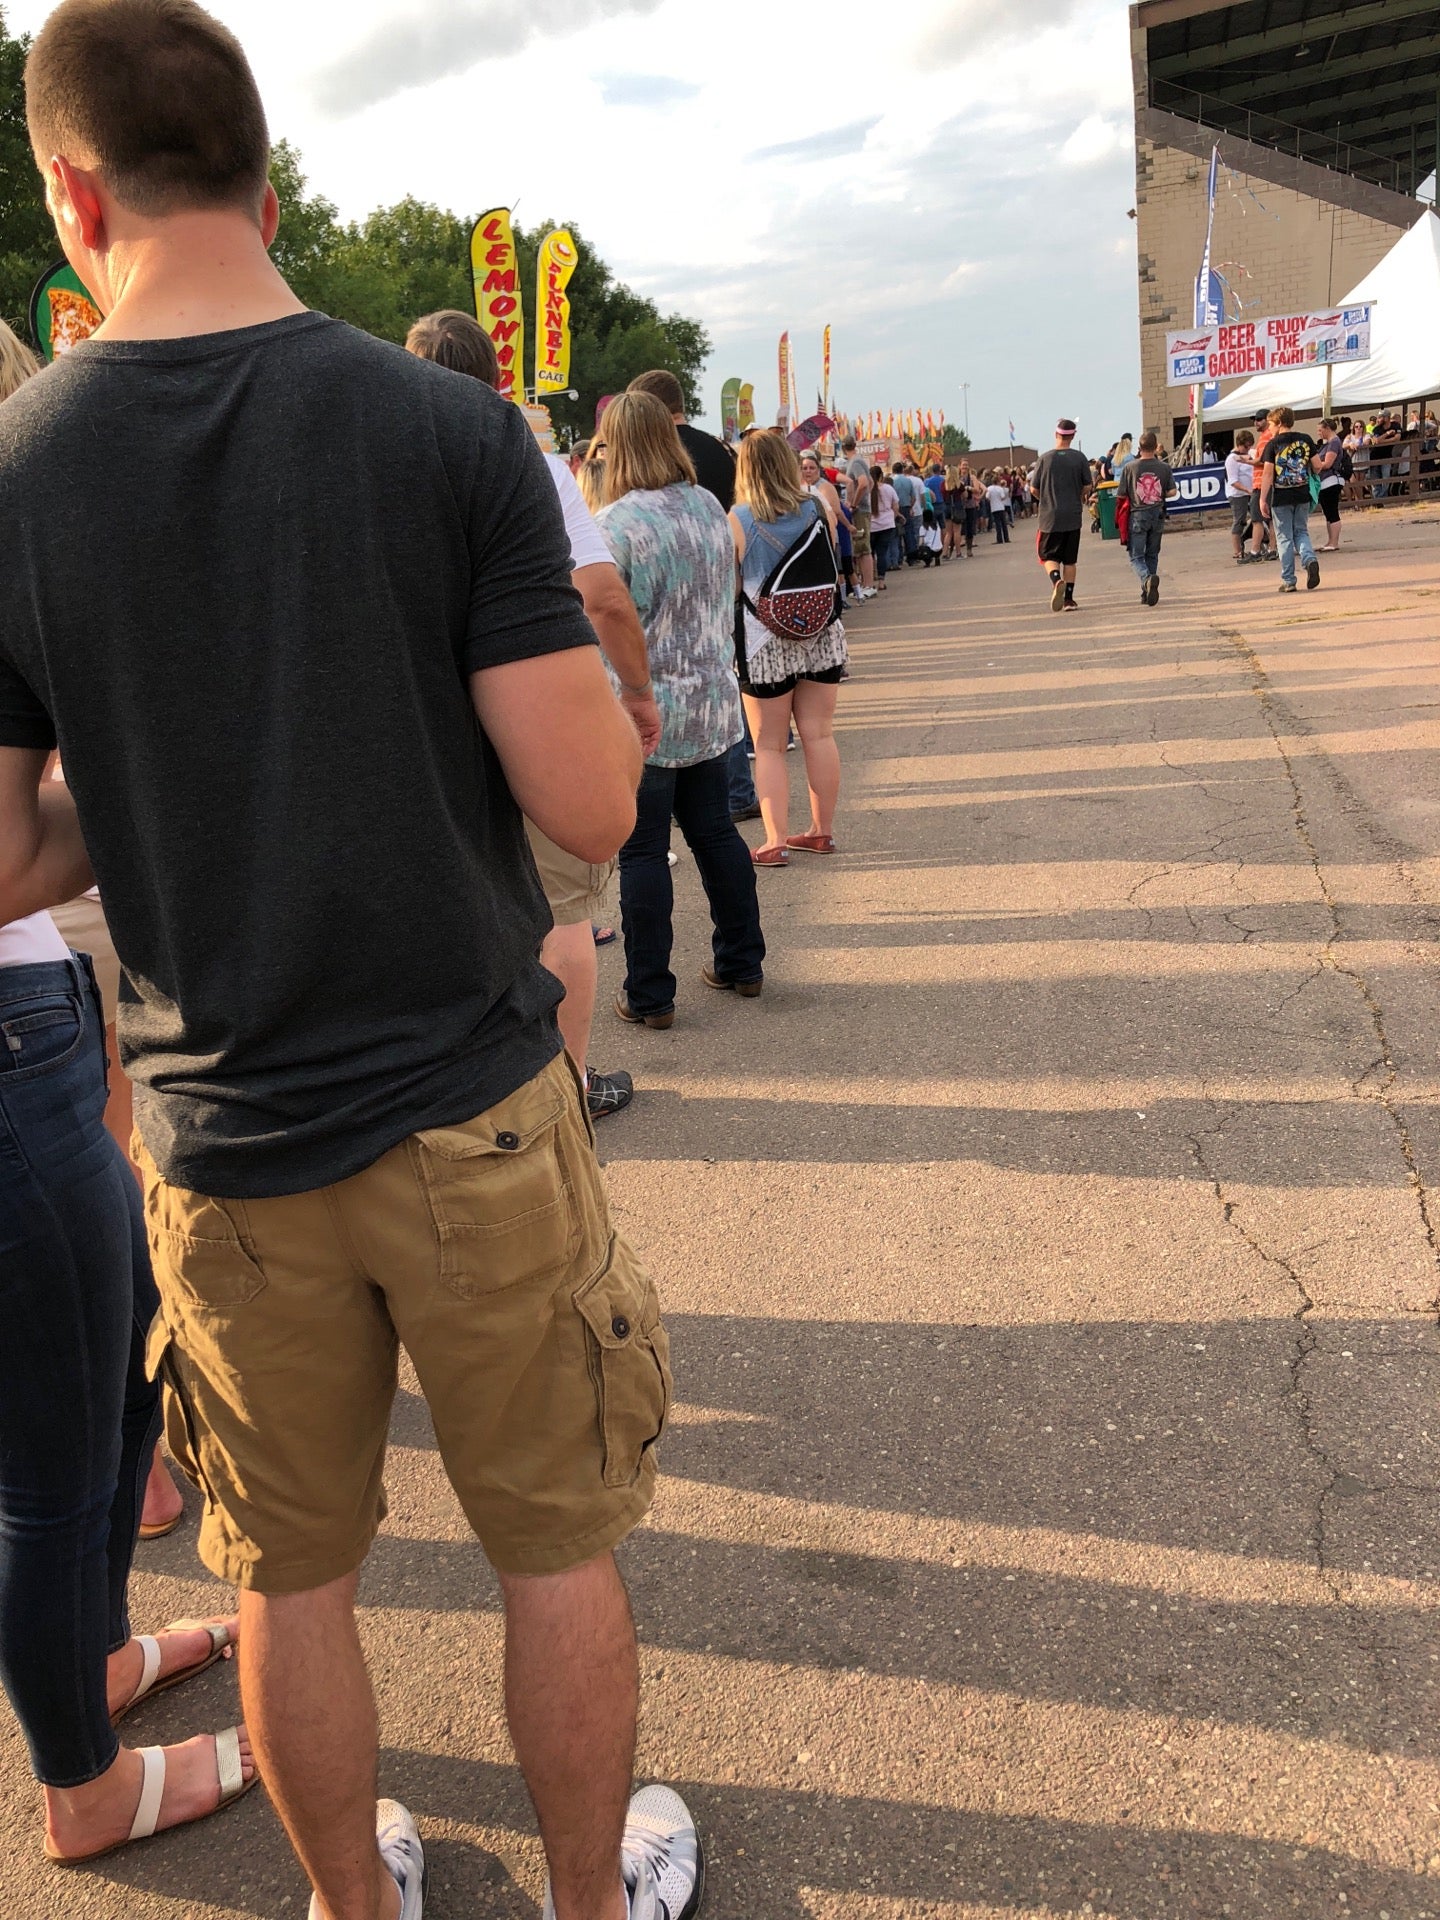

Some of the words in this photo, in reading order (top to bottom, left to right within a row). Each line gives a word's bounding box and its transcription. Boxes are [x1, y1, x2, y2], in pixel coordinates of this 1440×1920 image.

[1267, 315, 1309, 336] ENJOY
[1218, 322, 1256, 351] BEER
[1275, 333, 1300, 351] THE
[1179, 358, 1200, 368] BUD
[1208, 345, 1266, 378] GARDEN
[1270, 348, 1304, 368] FAIR!
[538, 370, 565, 384] CAKE
[1175, 365, 1204, 376] LIGHT
[855, 444, 886, 454] ONUTS
